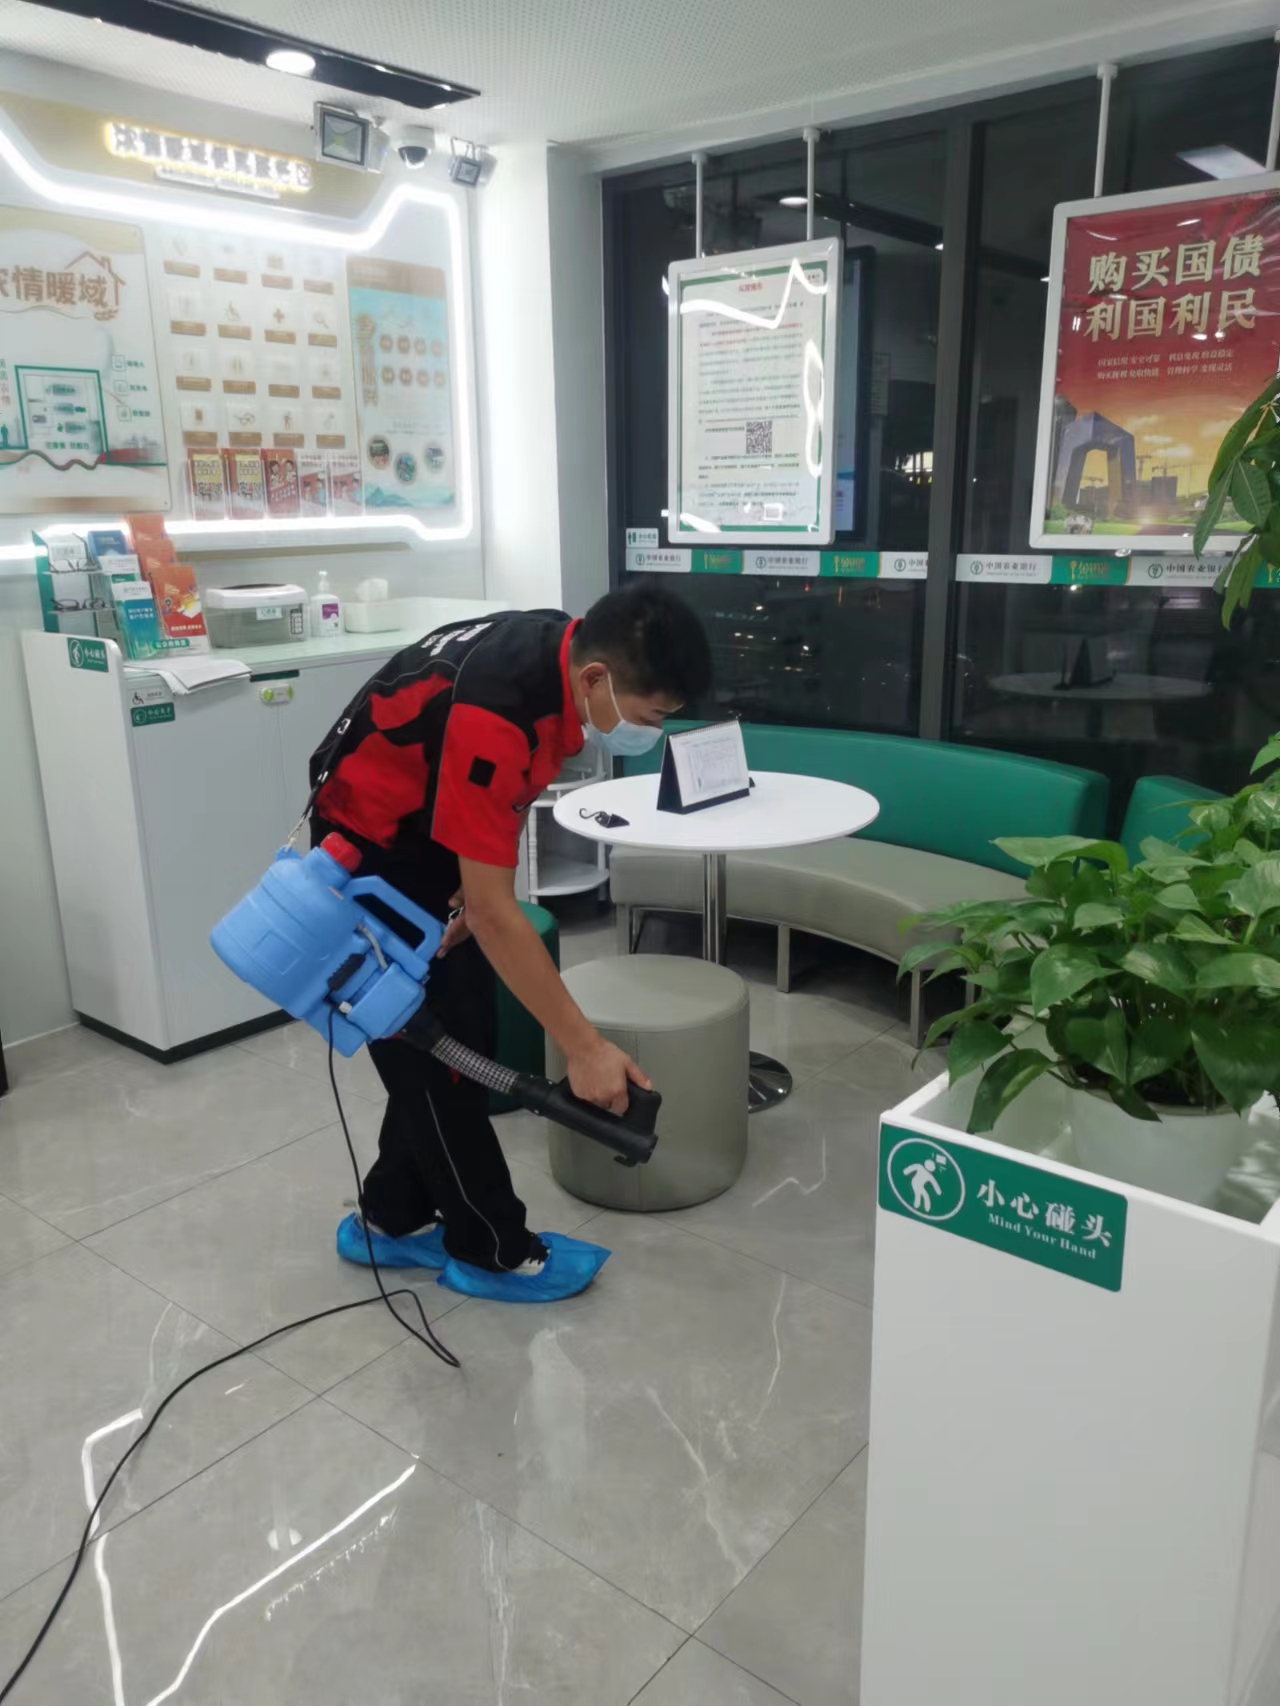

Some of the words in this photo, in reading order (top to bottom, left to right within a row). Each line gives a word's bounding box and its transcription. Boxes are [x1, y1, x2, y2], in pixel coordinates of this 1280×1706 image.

[1087, 233, 1265, 295] 购买国债
[1084, 287, 1257, 343] 利国利民
[985, 561, 1037, 571] 中国农业银行
[976, 1179, 1113, 1248] 小心碰头
[988, 1213, 1021, 1234] Mind
[1024, 1225, 1058, 1245] Your
[1060, 1238, 1097, 1260] Hand
